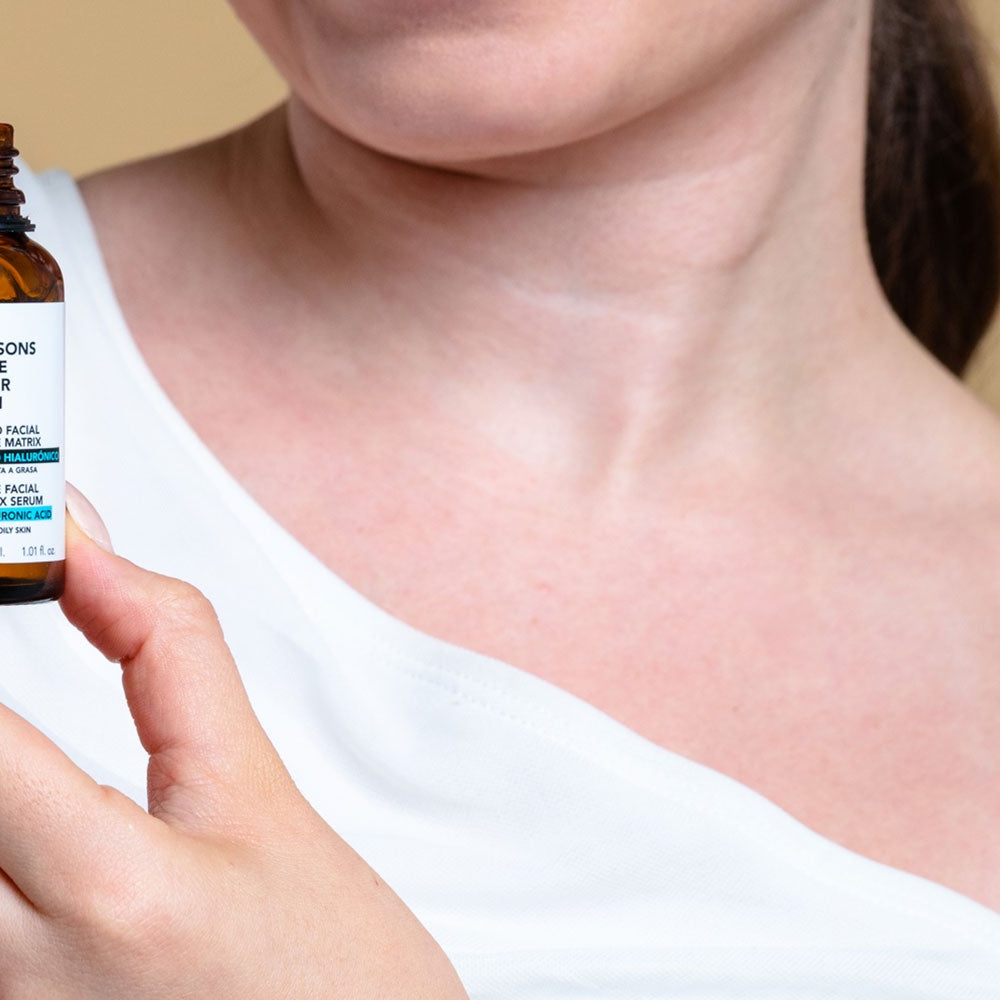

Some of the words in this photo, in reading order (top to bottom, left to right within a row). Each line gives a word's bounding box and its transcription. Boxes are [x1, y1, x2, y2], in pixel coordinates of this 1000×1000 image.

[6, 425, 40, 434] FACIAL
[4, 437, 42, 447] MATRIX
[4, 450, 59, 462] HIALURÓNICO
[5, 484, 39, 493] FACIAL
[11, 496, 43, 505] SERUM
[34, 510, 51, 519] ACID
[15, 526, 31, 534] SKIN
[22, 546, 37, 556] 1.01
